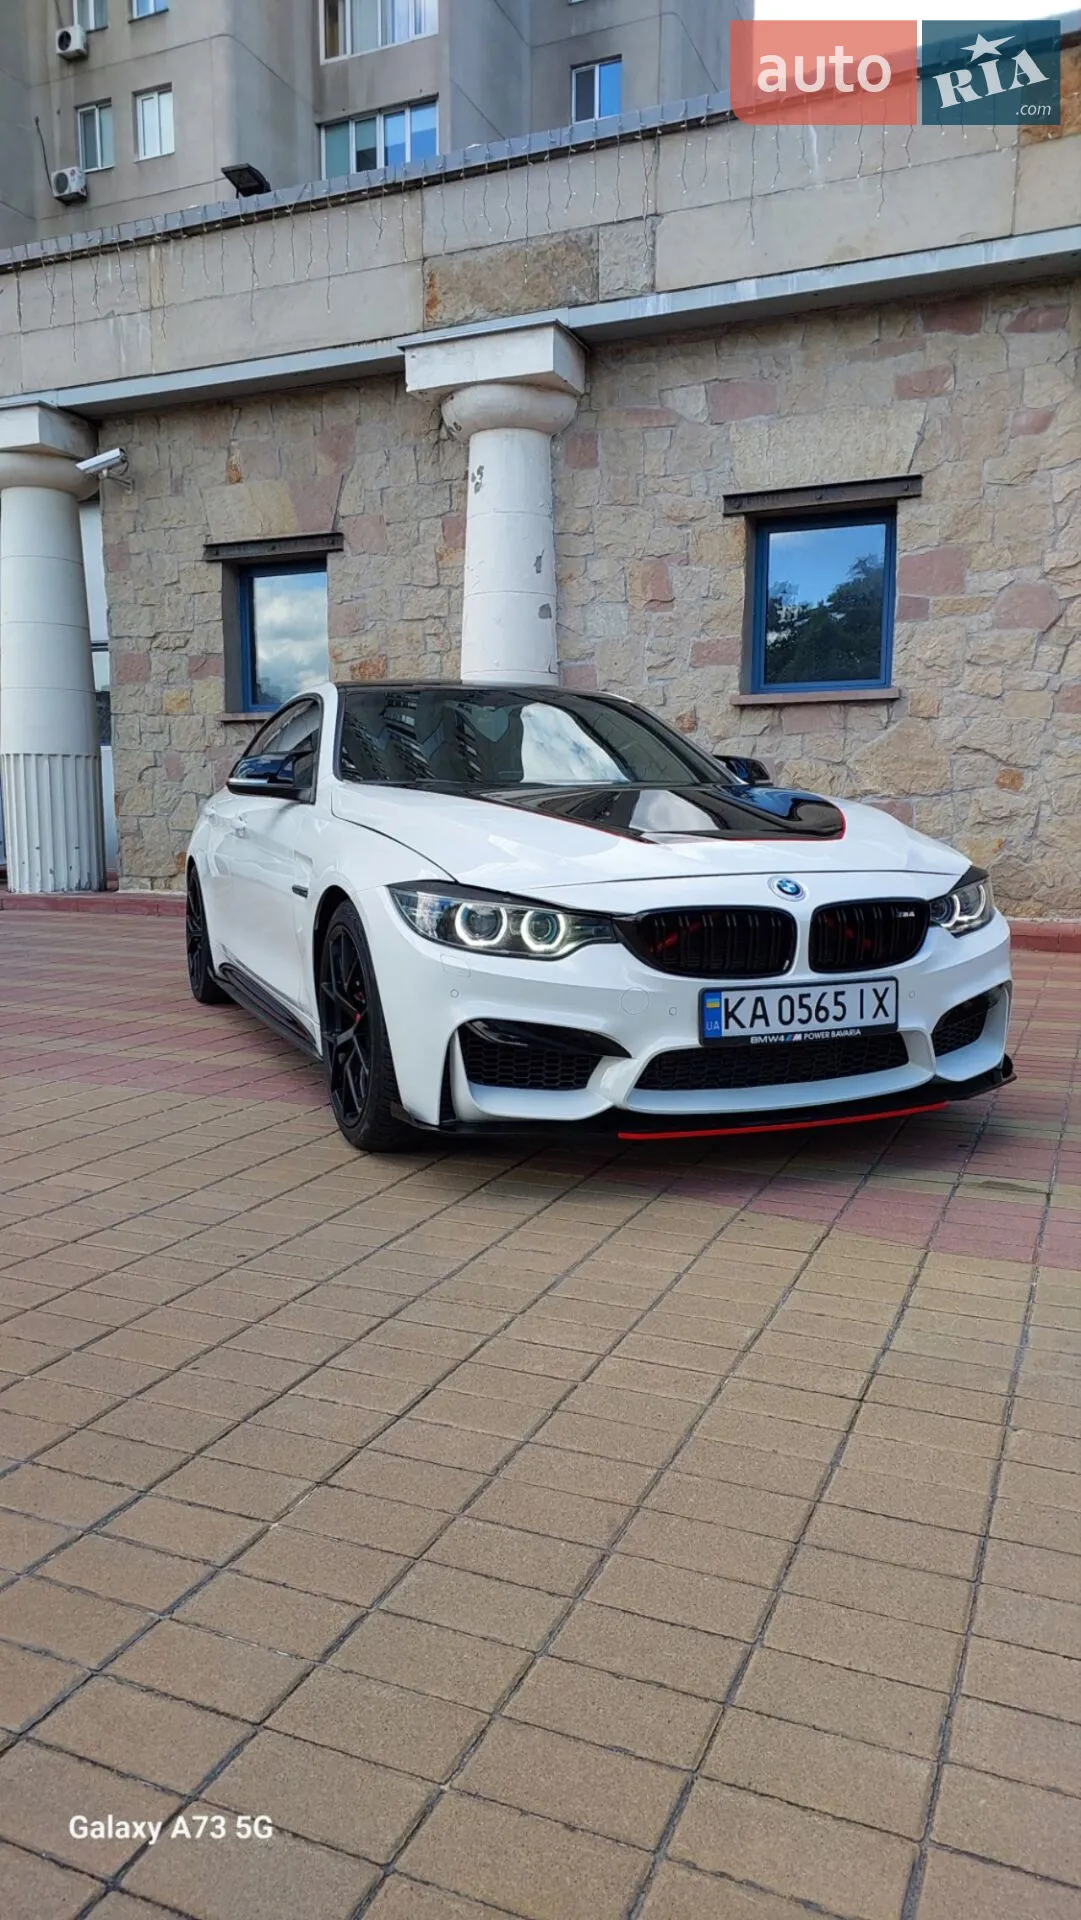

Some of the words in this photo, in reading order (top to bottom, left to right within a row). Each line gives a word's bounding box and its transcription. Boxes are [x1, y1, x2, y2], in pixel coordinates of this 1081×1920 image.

[724, 996, 771, 1030] KA
[777, 990, 847, 1026] 0565
[859, 986, 890, 1020] IX
[706, 1020, 720, 1031] UA
[803, 1031, 830, 1040] POWER
[830, 1028, 862, 1039] BAVARIA
